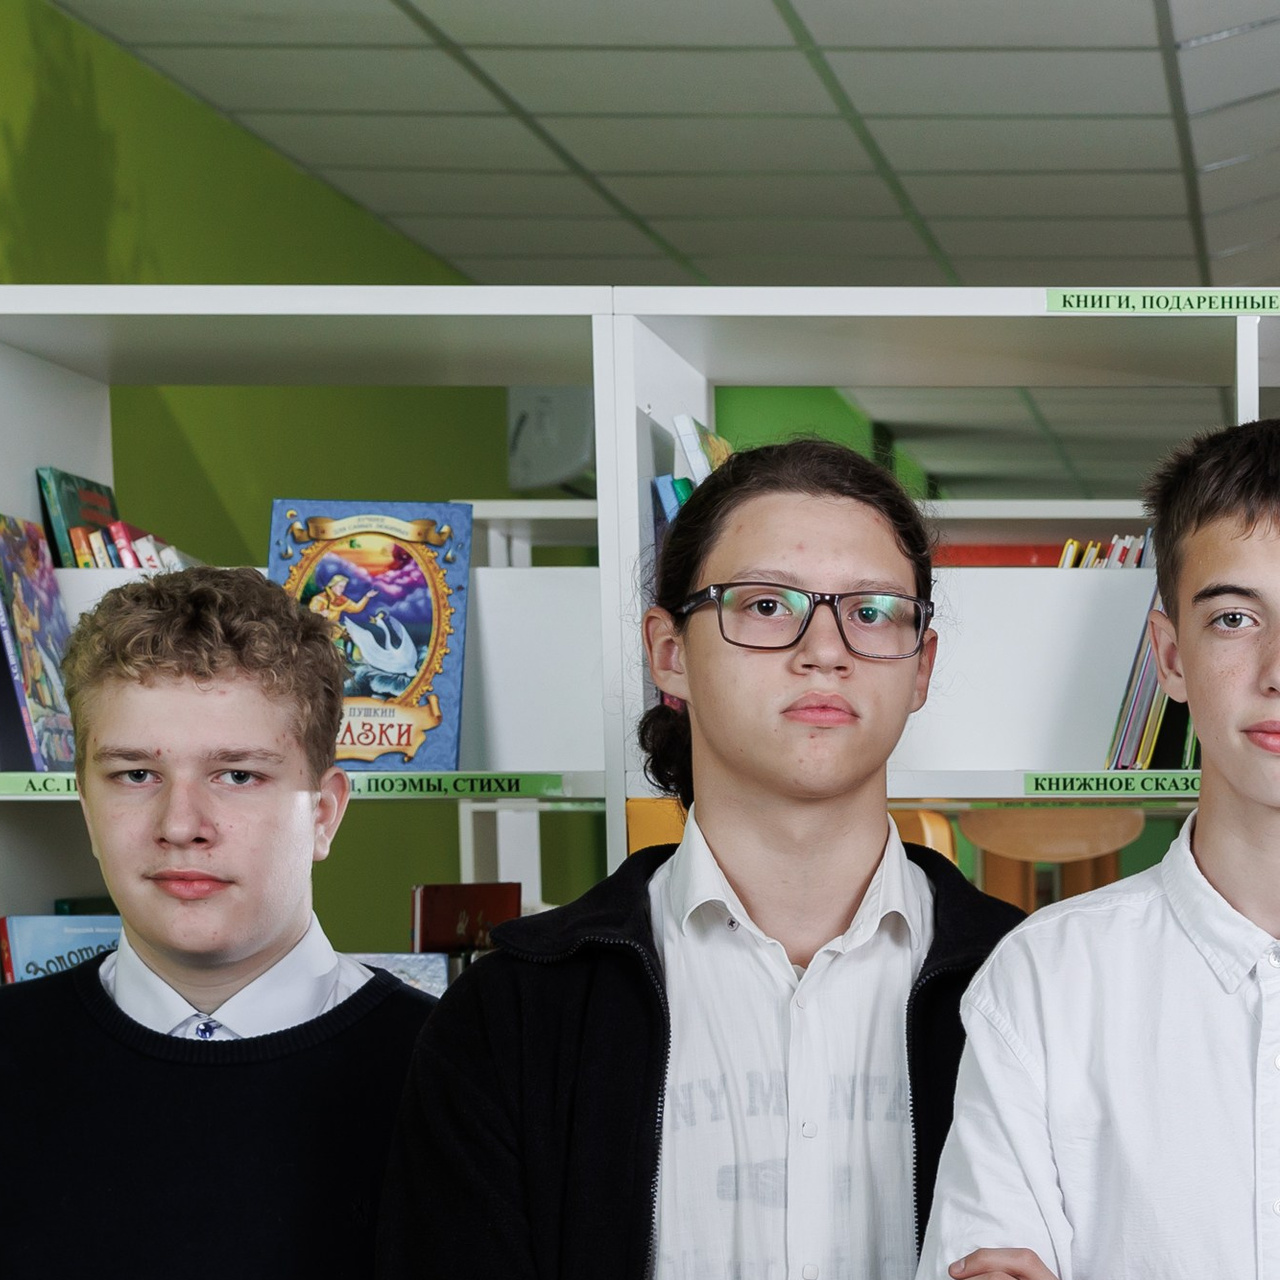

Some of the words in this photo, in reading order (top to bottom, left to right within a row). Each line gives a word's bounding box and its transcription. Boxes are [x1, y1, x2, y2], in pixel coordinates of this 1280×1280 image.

[1061, 294, 1137, 312] КНИГИ,
[1141, 294, 1280, 310] ПОДАРЕННЫЕ
[349, 707, 396, 718] ПУШКИН
[336, 721, 413, 746] АЗКИ
[25, 778, 60, 792] А.С.
[367, 778, 448, 795] ПОЭМЫ,
[453, 778, 520, 792] СТИХИ
[1034, 777, 1135, 791] КНИЖНОЕ
